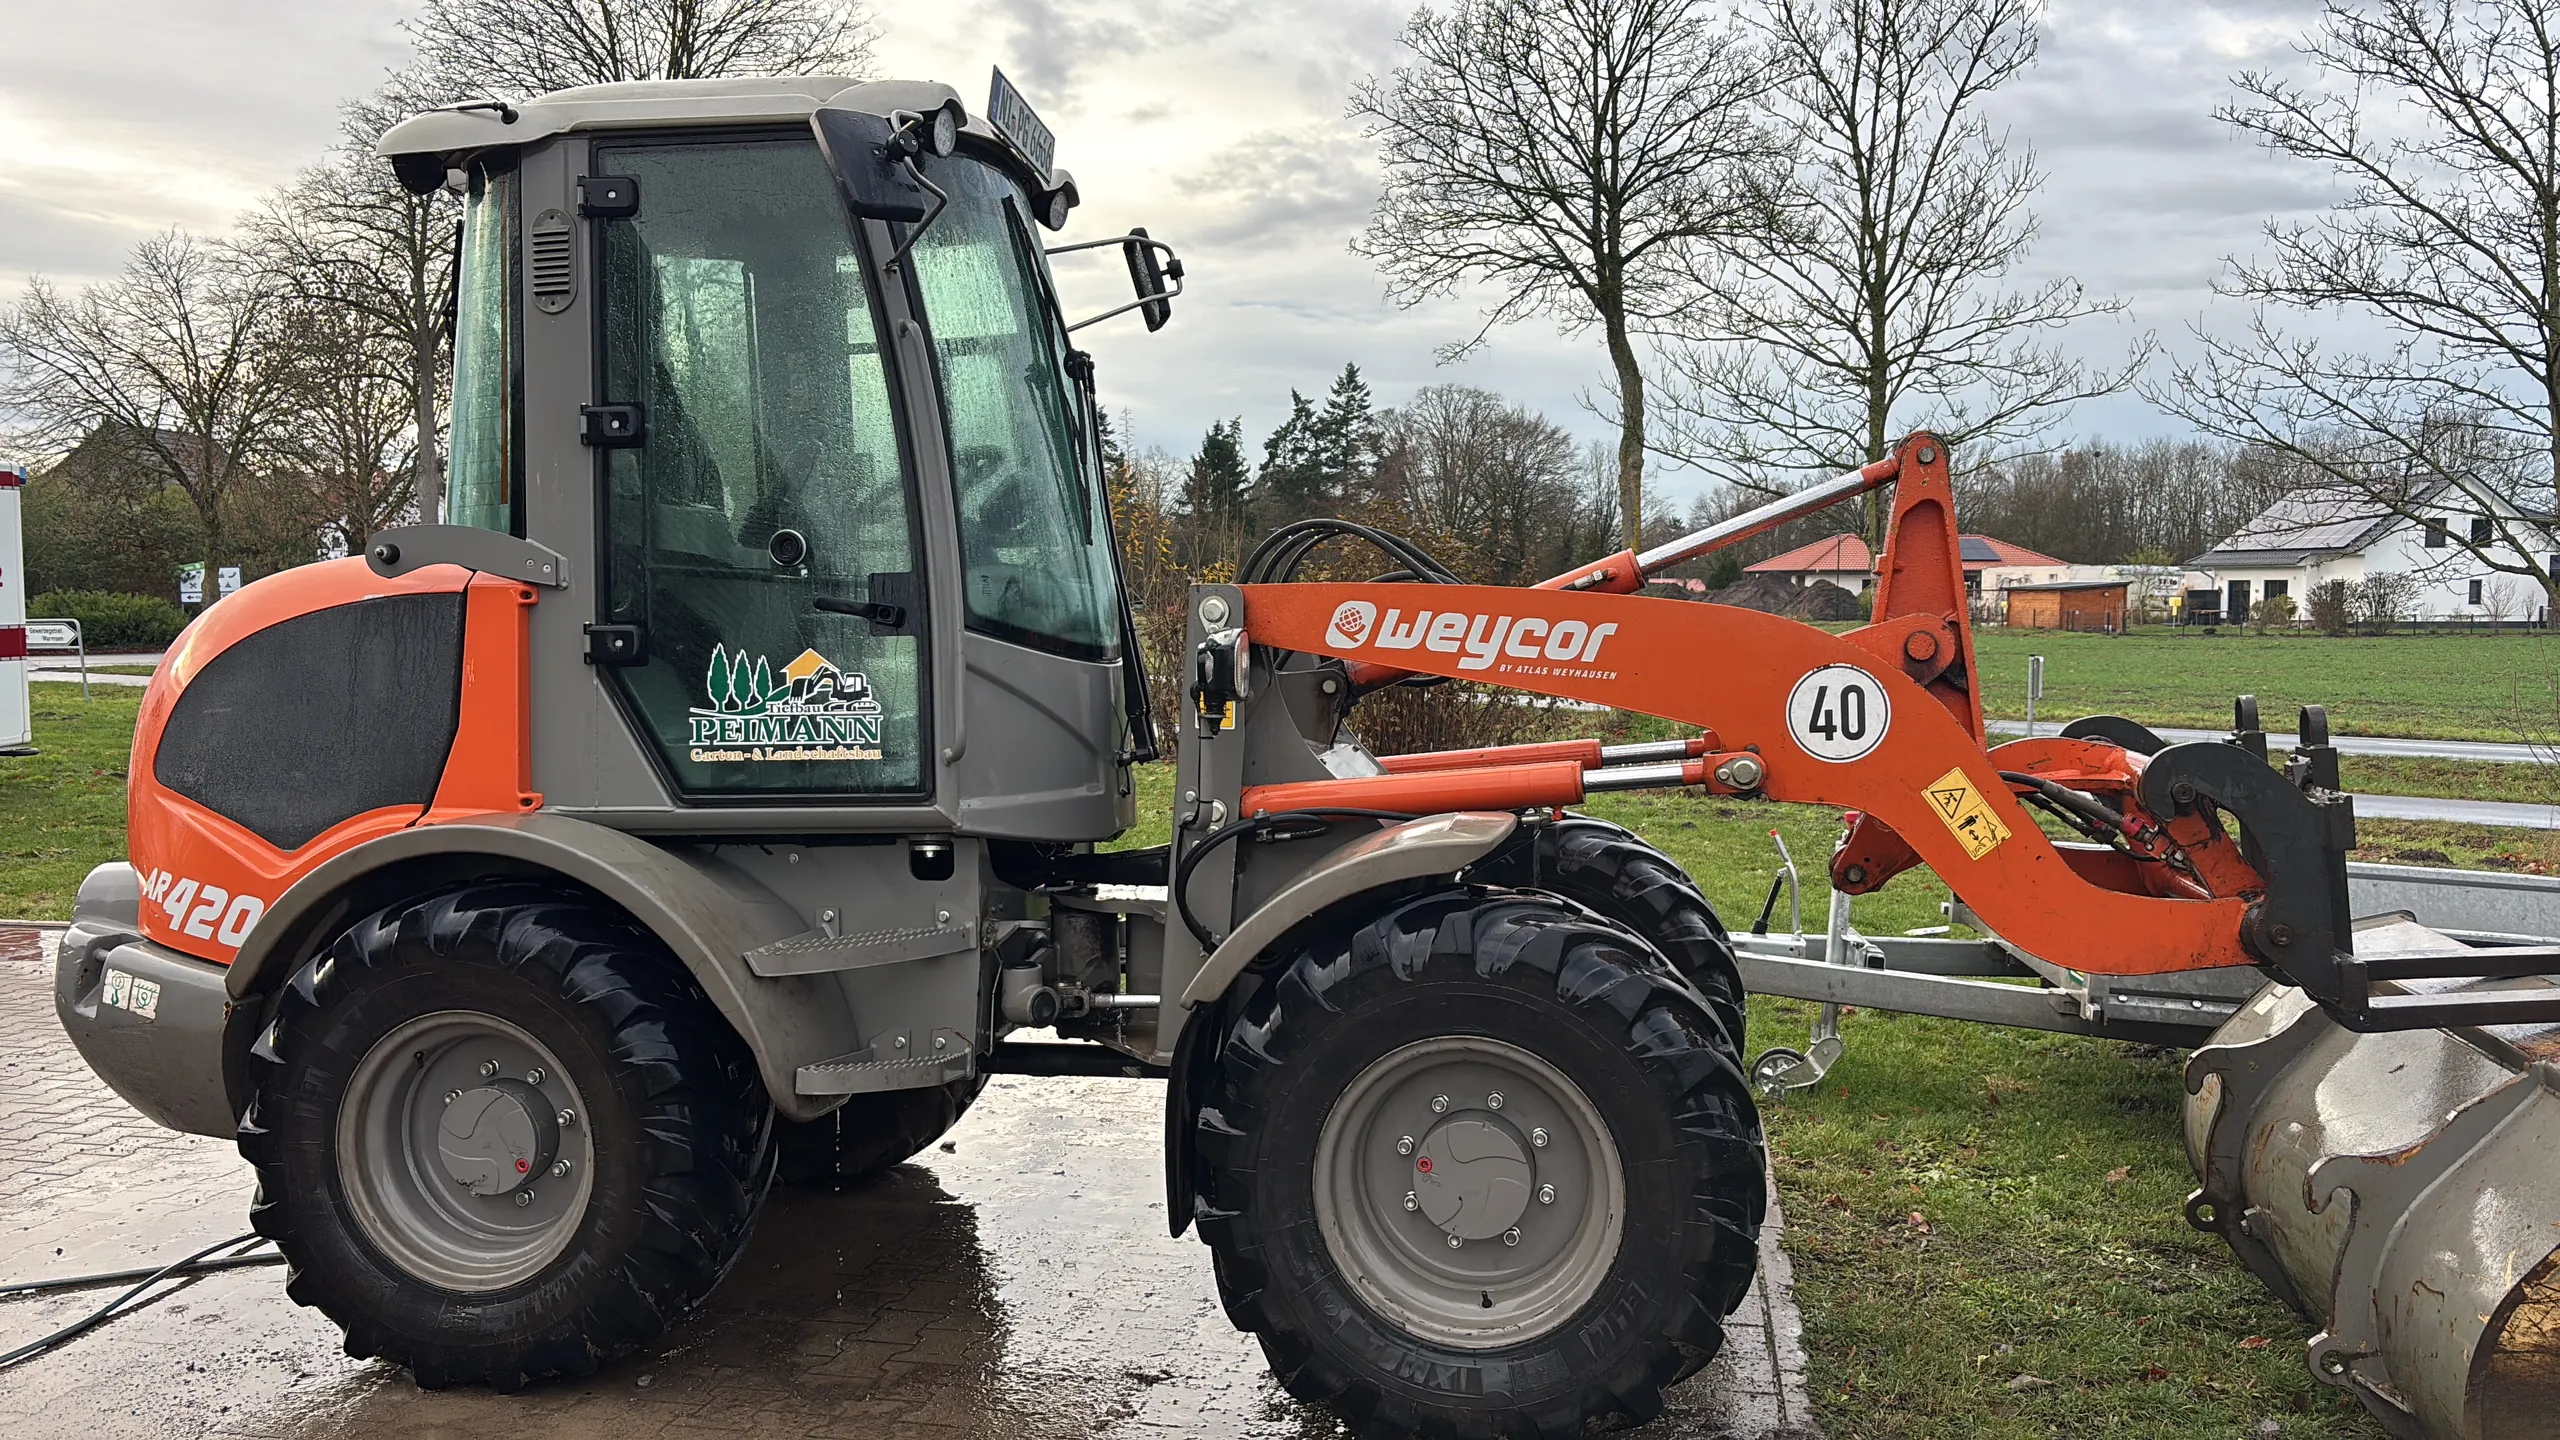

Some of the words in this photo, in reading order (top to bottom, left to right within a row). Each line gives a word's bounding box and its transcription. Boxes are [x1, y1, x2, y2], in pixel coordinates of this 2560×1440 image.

[999, 85, 1013, 131] NI
[1016, 105, 1031, 149] PG
[1030, 123, 1052, 174] 6666
[1374, 608, 1619, 671] weycor
[1499, 664, 1512, 673] BY
[1515, 665, 1548, 676] ATLAS
[1552, 667, 1618, 681] WEYHAUSEN
[767, 702, 823, 714] Tiefbau
[1808, 684, 1866, 741] 40
[689, 716, 883, 745] PEIMANN
[766, 745, 883, 761] Landschaftsbau
